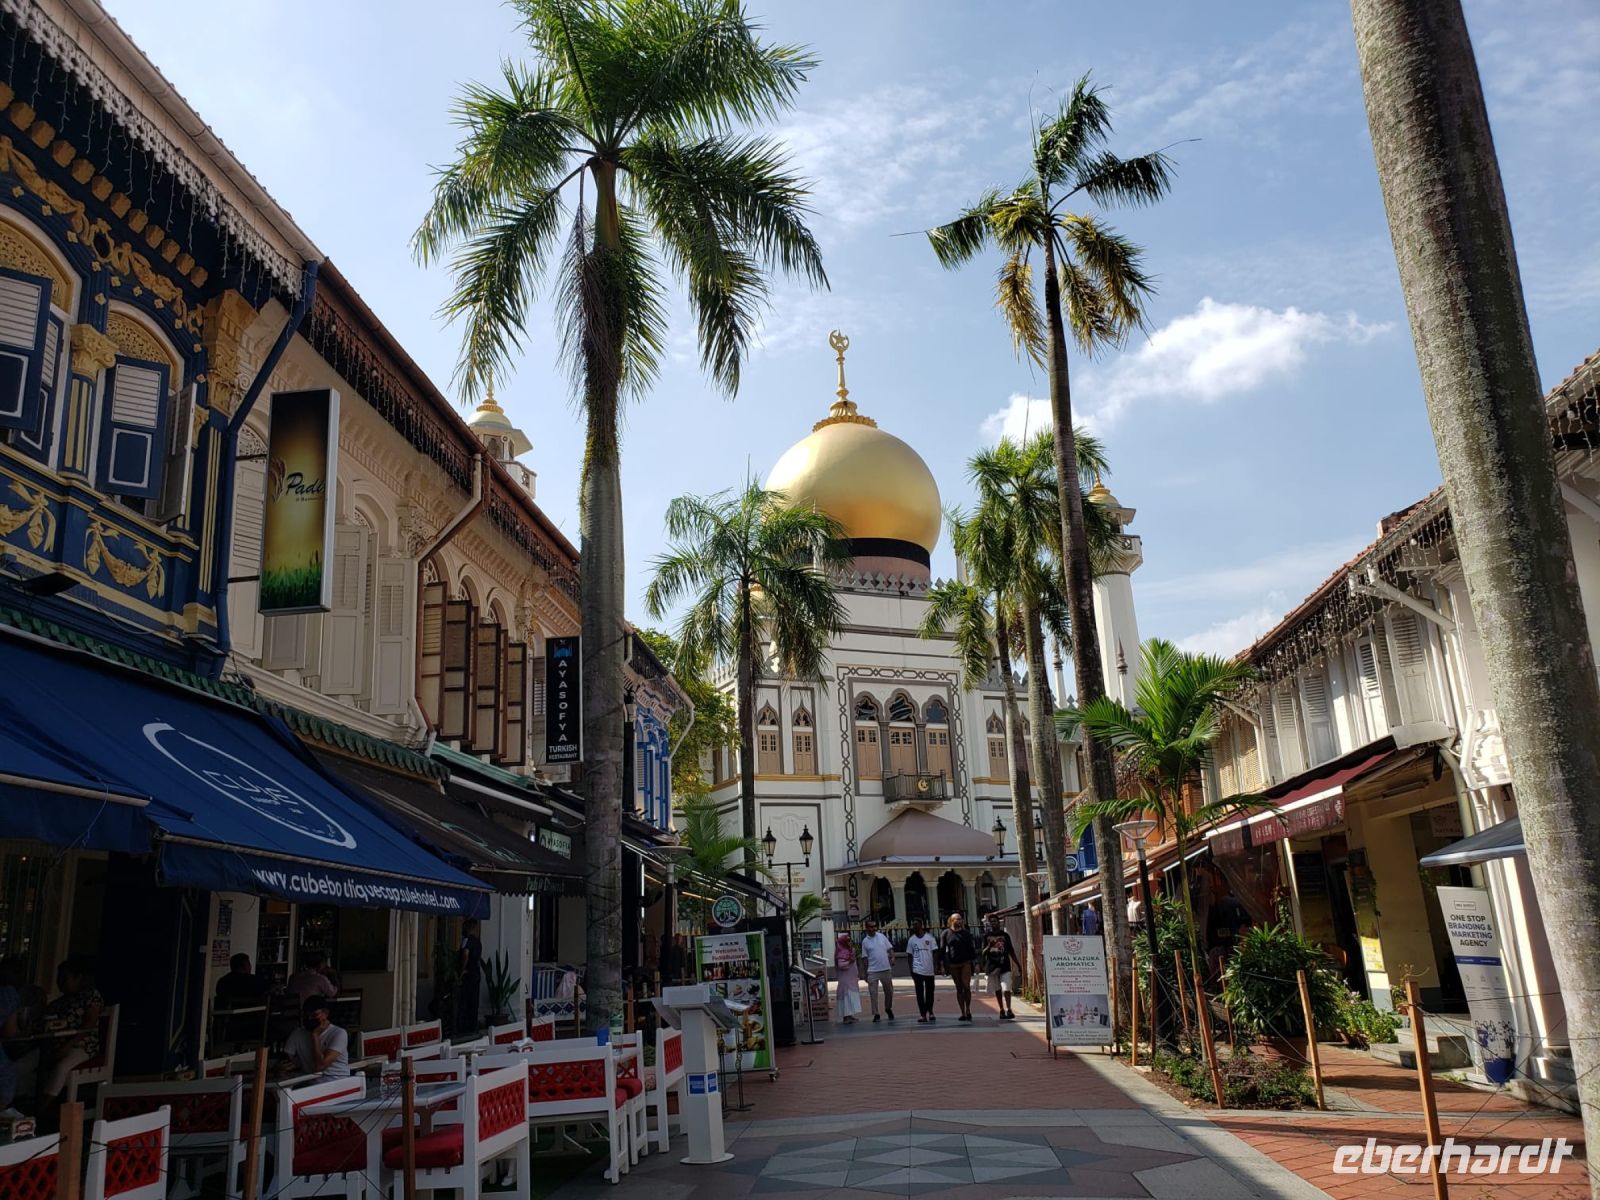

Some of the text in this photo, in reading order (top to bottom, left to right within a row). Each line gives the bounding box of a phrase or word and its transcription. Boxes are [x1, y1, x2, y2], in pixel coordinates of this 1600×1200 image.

[558, 660, 568, 742] AYASOFYA
[549, 744, 578, 753] TURKISH
[1450, 914, 1486, 922] ONE STOP
[1448, 922, 1486, 931] BRANDING
[1451, 930, 1493, 939] MARKETING
[1460, 939, 1488, 947] AGENCY
